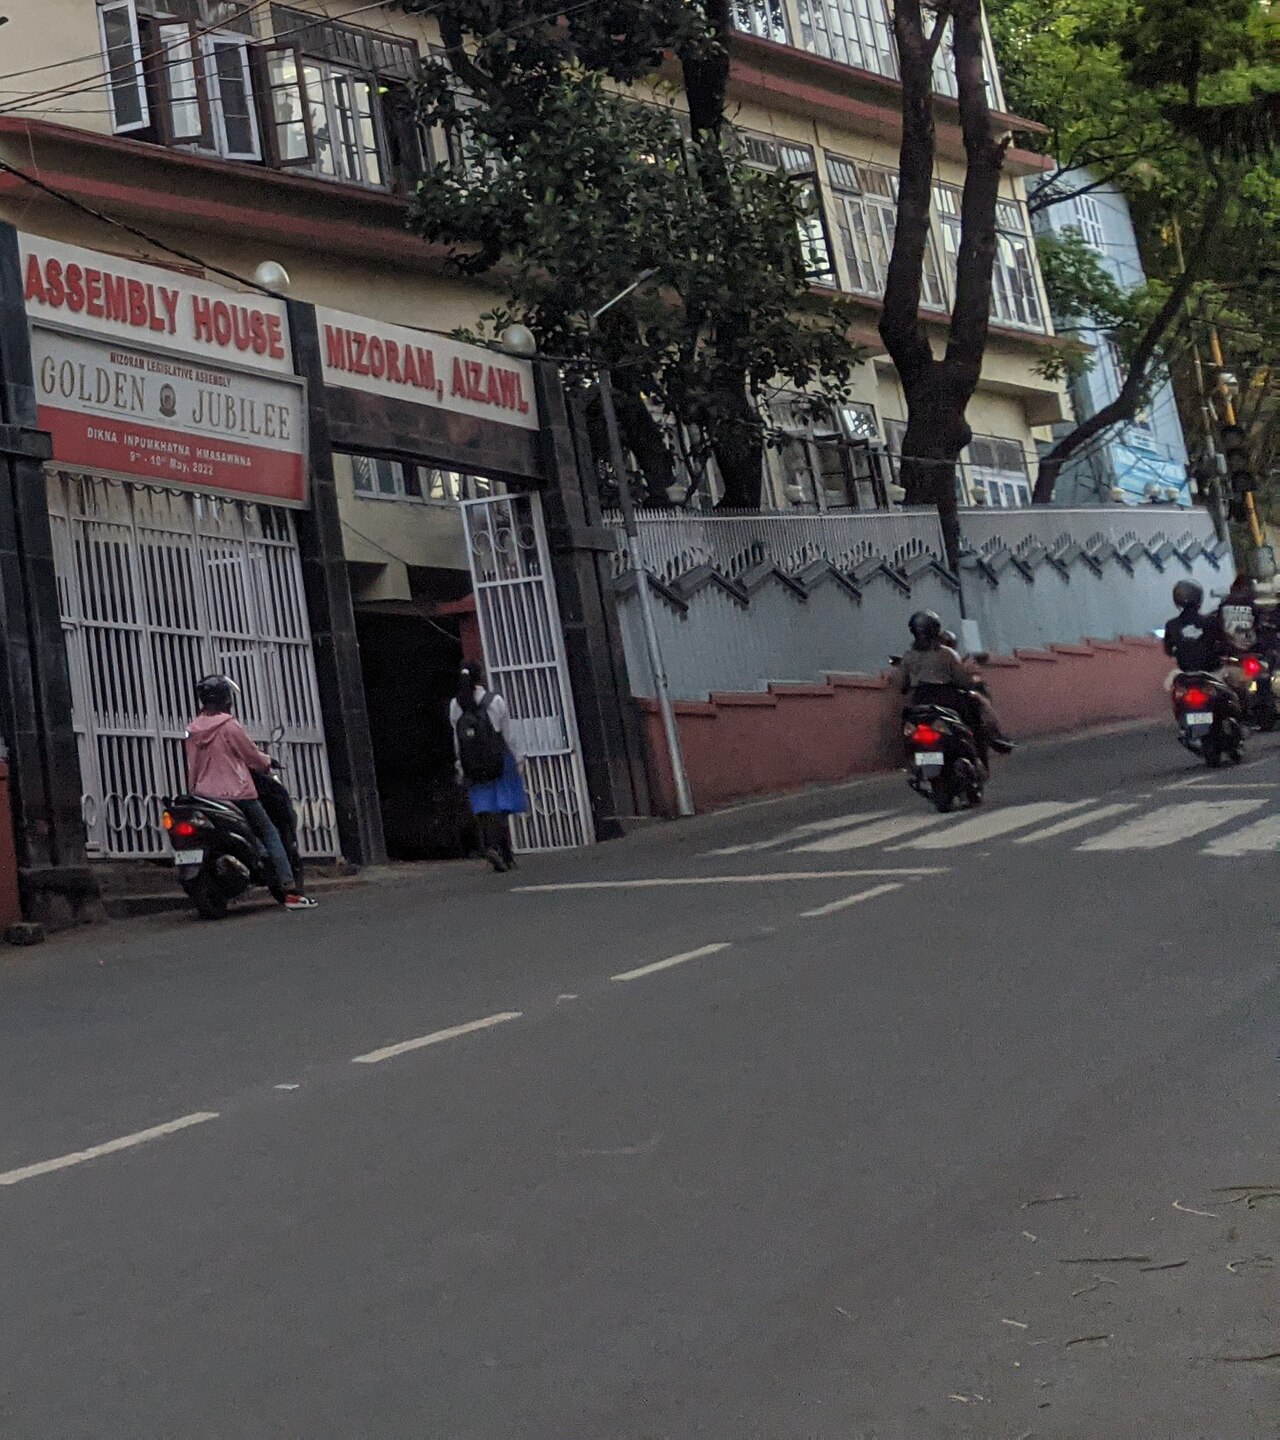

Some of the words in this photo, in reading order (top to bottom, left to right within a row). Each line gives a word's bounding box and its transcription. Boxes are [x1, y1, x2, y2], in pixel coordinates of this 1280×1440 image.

[24, 253, 179, 335] ASSEMBLY
[191, 294, 284, 359] HOUSE
[41, 355, 145, 412] GOLDEN
[192, 388, 291, 440] JUBILEE
[110, 351, 145, 369] MIZORAM
[147, 360, 193, 381] LEGISLATIVE
[195, 371, 232, 388] ASSEMBLY
[324, 324, 444, 402] MIZORAM,
[450, 356, 529, 414] AIZAWL
[87, 427, 117, 443] DIKNA
[124, 434, 191, 457] INPUMKHATNA
[193, 462, 213, 476] 2022
